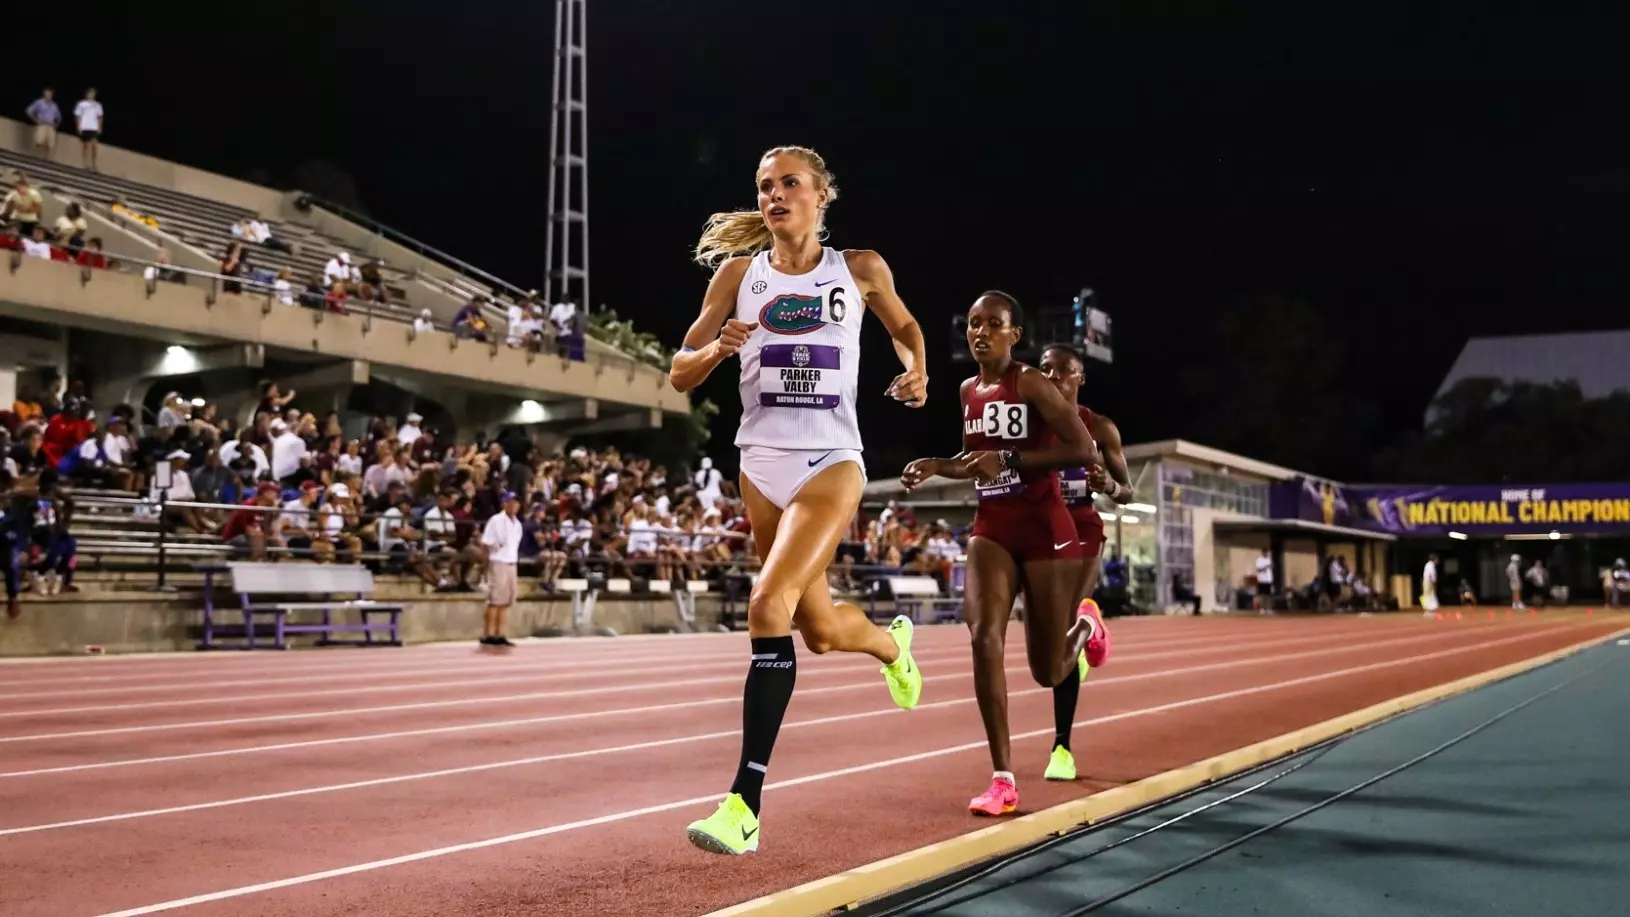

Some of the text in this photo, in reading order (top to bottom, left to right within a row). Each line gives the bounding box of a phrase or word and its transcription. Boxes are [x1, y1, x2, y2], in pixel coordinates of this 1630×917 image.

[752, 281, 767, 293] SEC
[828, 287, 846, 322] 6
[780, 368, 821, 381] PARKER
[783, 381, 817, 393] VALBY
[776, 395, 795, 403] BATON
[965, 418, 983, 435] LAB
[1501, 488, 1546, 502] HOME OF
[1408, 498, 1630, 524] NATIONAL CHAMPION
